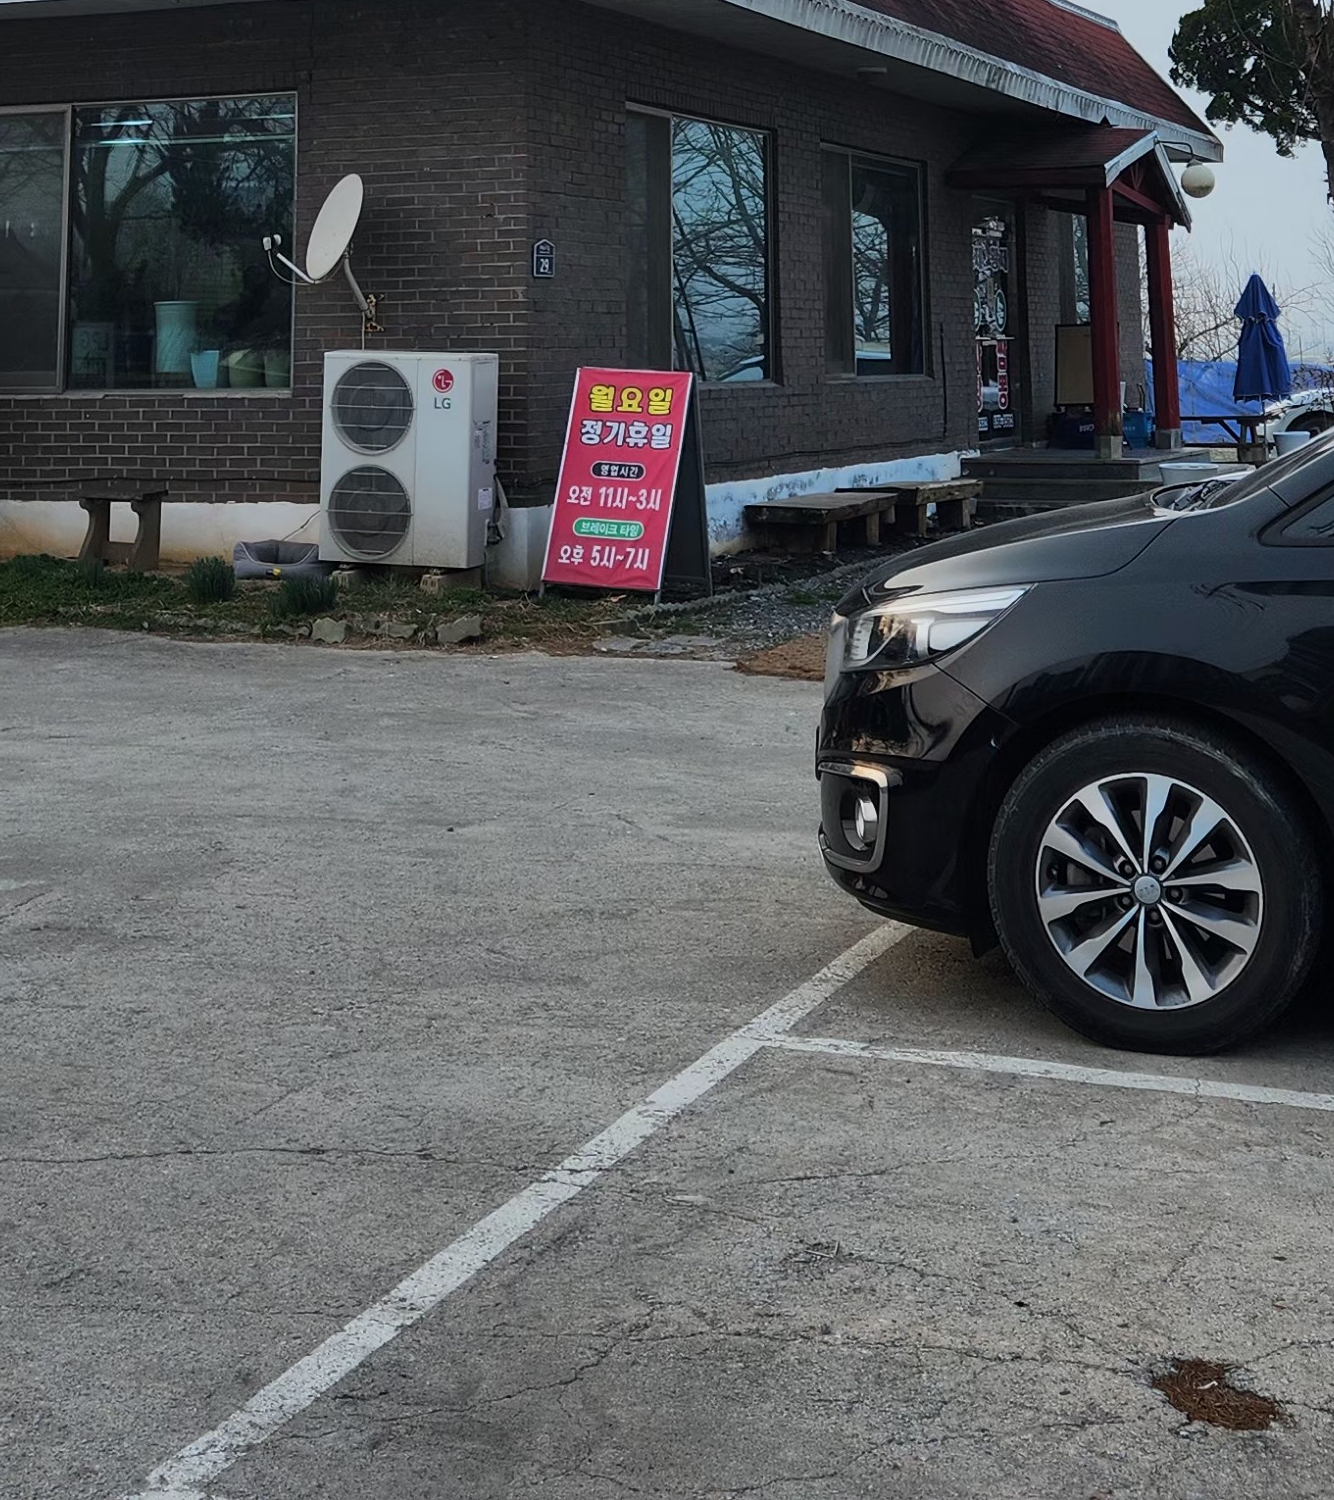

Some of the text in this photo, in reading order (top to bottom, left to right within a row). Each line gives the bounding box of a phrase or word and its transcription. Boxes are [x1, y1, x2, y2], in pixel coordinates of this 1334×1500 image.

[434, 397, 452, 410] LG
[589, 384, 674, 415] 월요일
[580, 419, 673, 449] 정기휴일
[600, 464, 639, 478] 영업시간
[567, 485, 662, 511] 오전 11시~3시
[580, 521, 640, 538] 브레이크 타임
[558, 545, 650, 571] 오후 5시~7시
